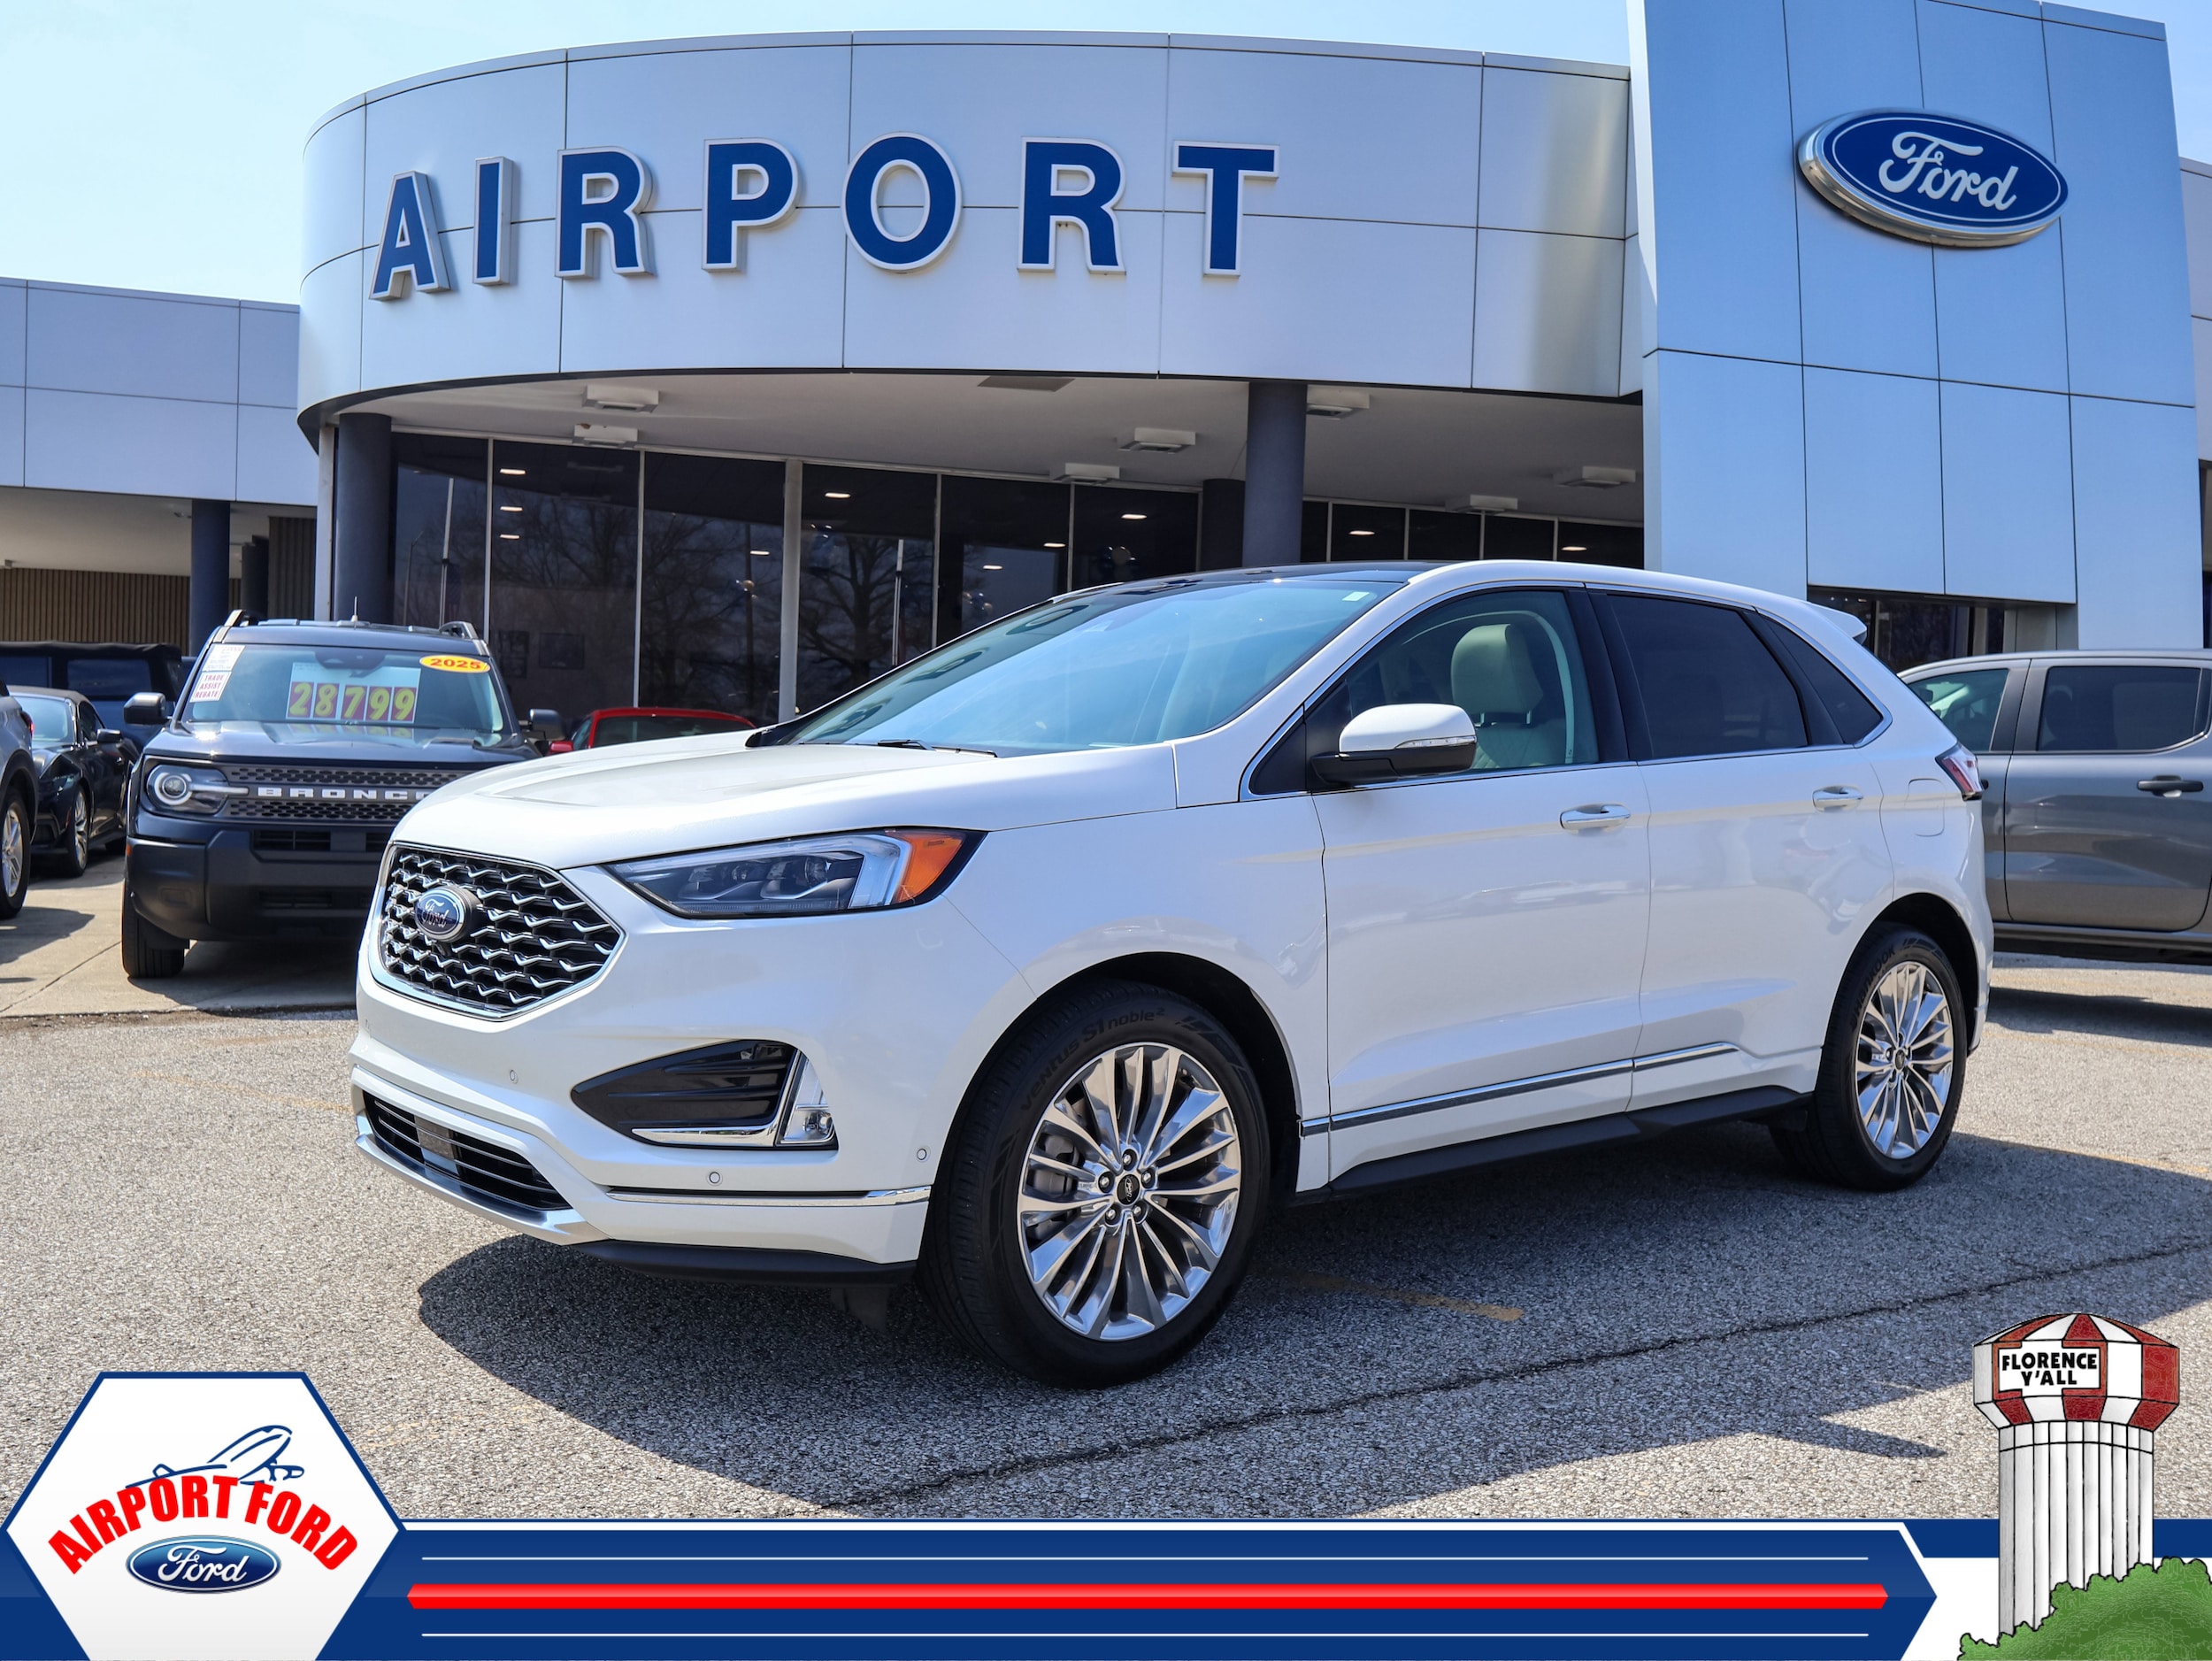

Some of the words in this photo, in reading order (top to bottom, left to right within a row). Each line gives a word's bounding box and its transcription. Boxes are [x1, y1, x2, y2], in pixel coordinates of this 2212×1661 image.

[1878, 132, 2018, 211] Ford
[369, 131, 1279, 301] AIRPORT
[430, 657, 481, 670] 2025
[288, 682, 415, 721] 28799
[421, 898, 449, 928] Ford
